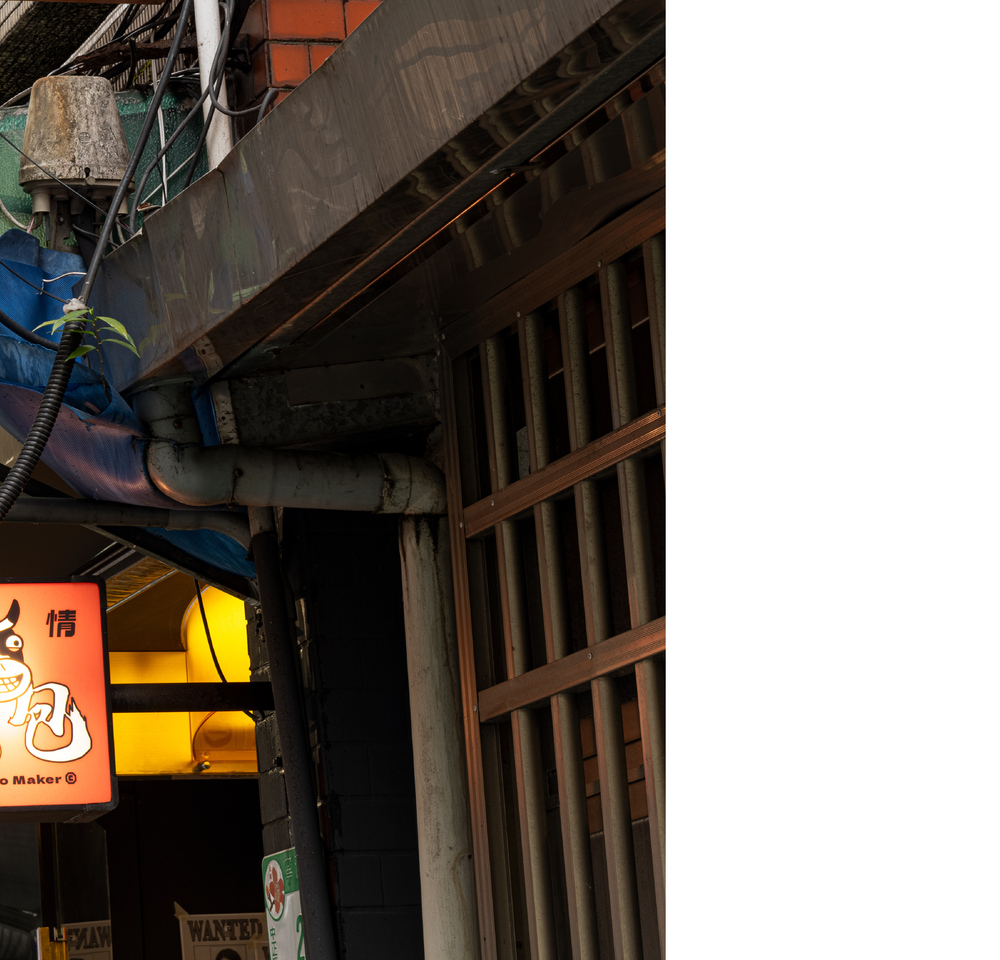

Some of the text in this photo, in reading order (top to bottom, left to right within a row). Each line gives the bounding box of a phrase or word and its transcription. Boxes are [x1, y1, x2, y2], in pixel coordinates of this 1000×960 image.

[45, 609, 77, 638] 情
[12, 774, 62, 785] Maker
[187, 918, 263, 942] WANTED
